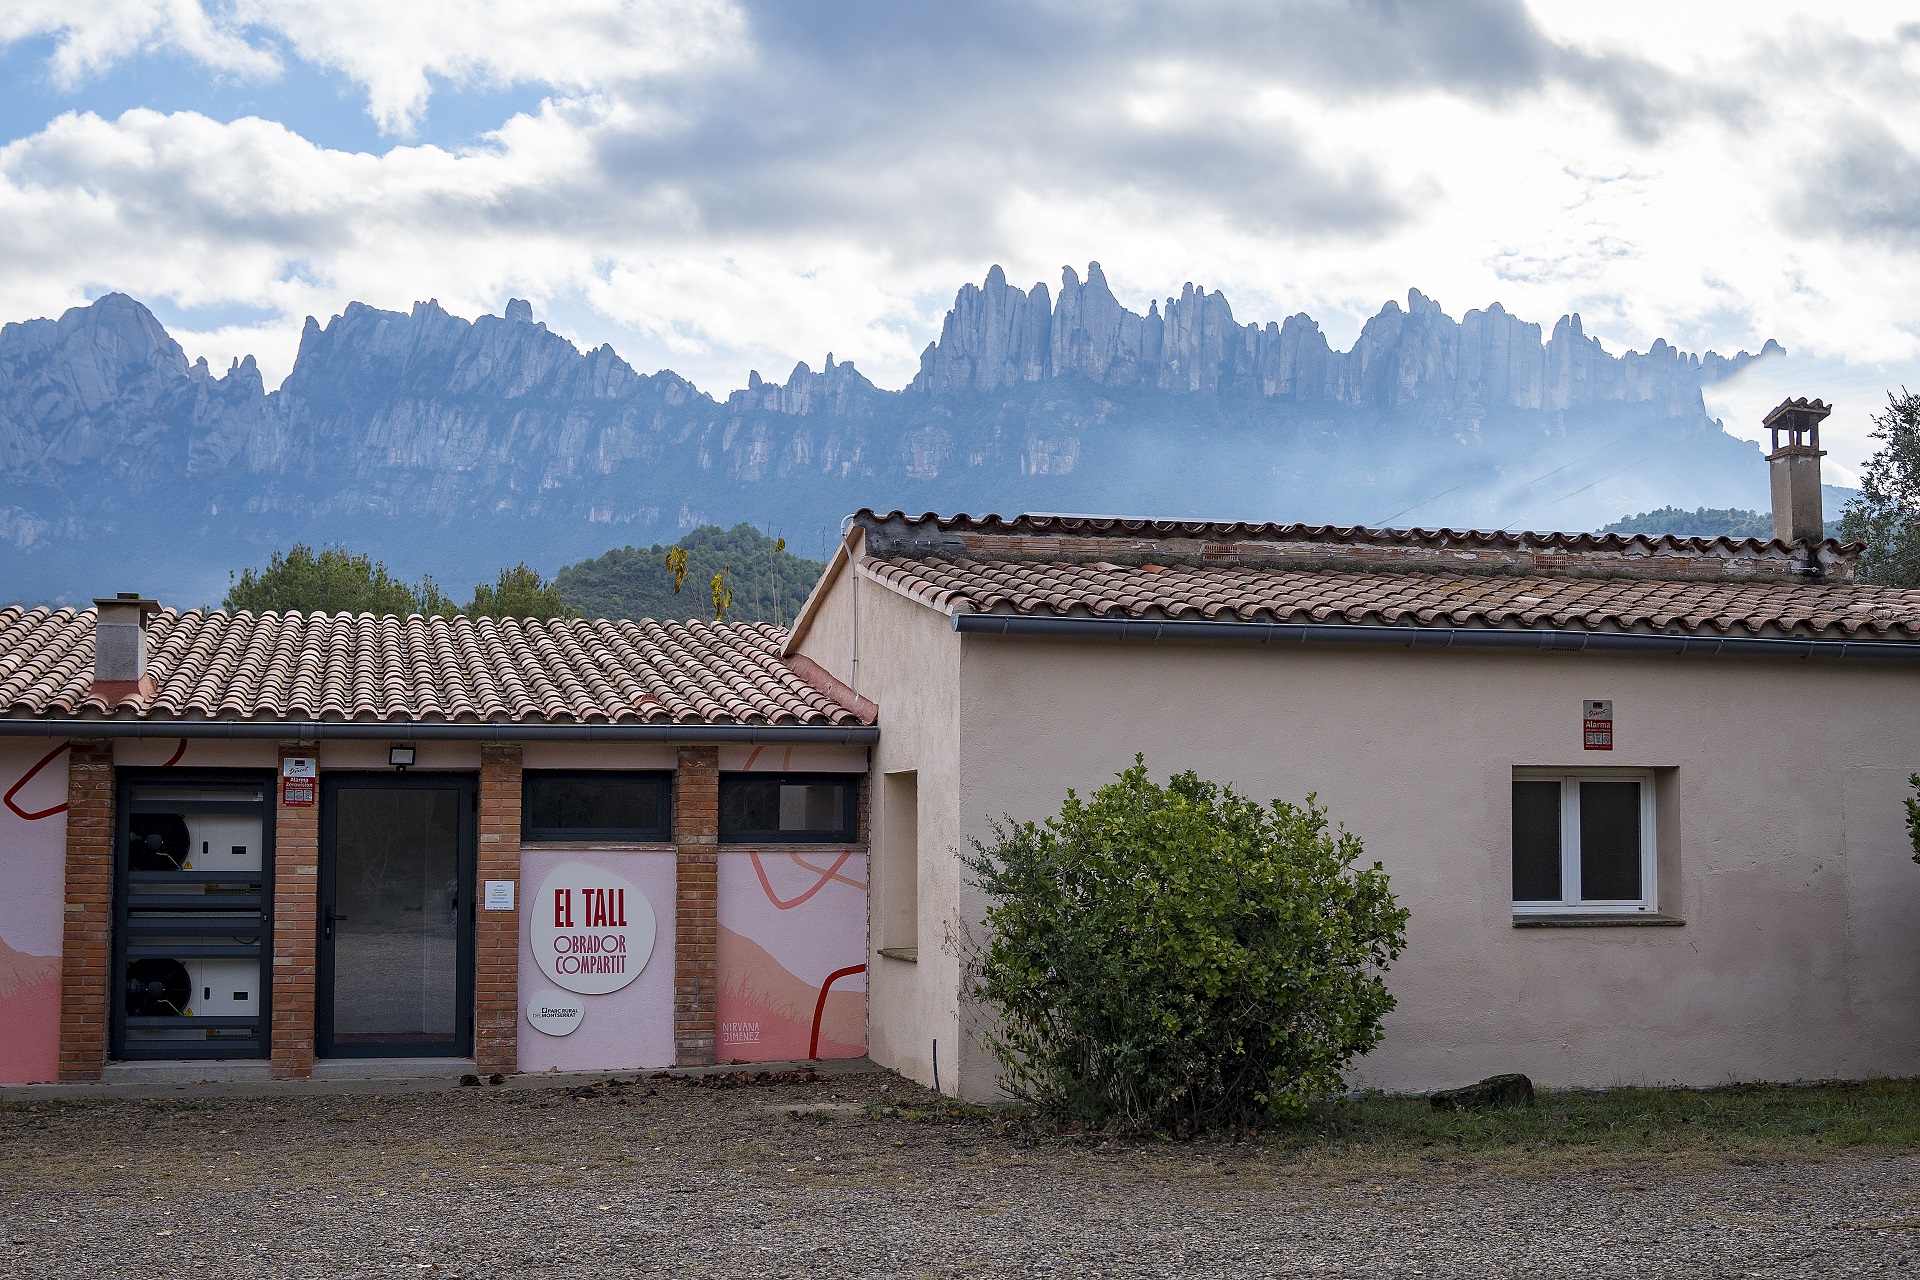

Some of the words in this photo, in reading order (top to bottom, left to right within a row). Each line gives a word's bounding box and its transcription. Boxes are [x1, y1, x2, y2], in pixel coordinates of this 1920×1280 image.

[554, 888, 574, 928] EL
[581, 888, 627, 928] TALL
[553, 934, 627, 954] OBRADOR
[555, 955, 627, 975] COMPARTIT
[722, 1022, 760, 1032] NIRVANA
